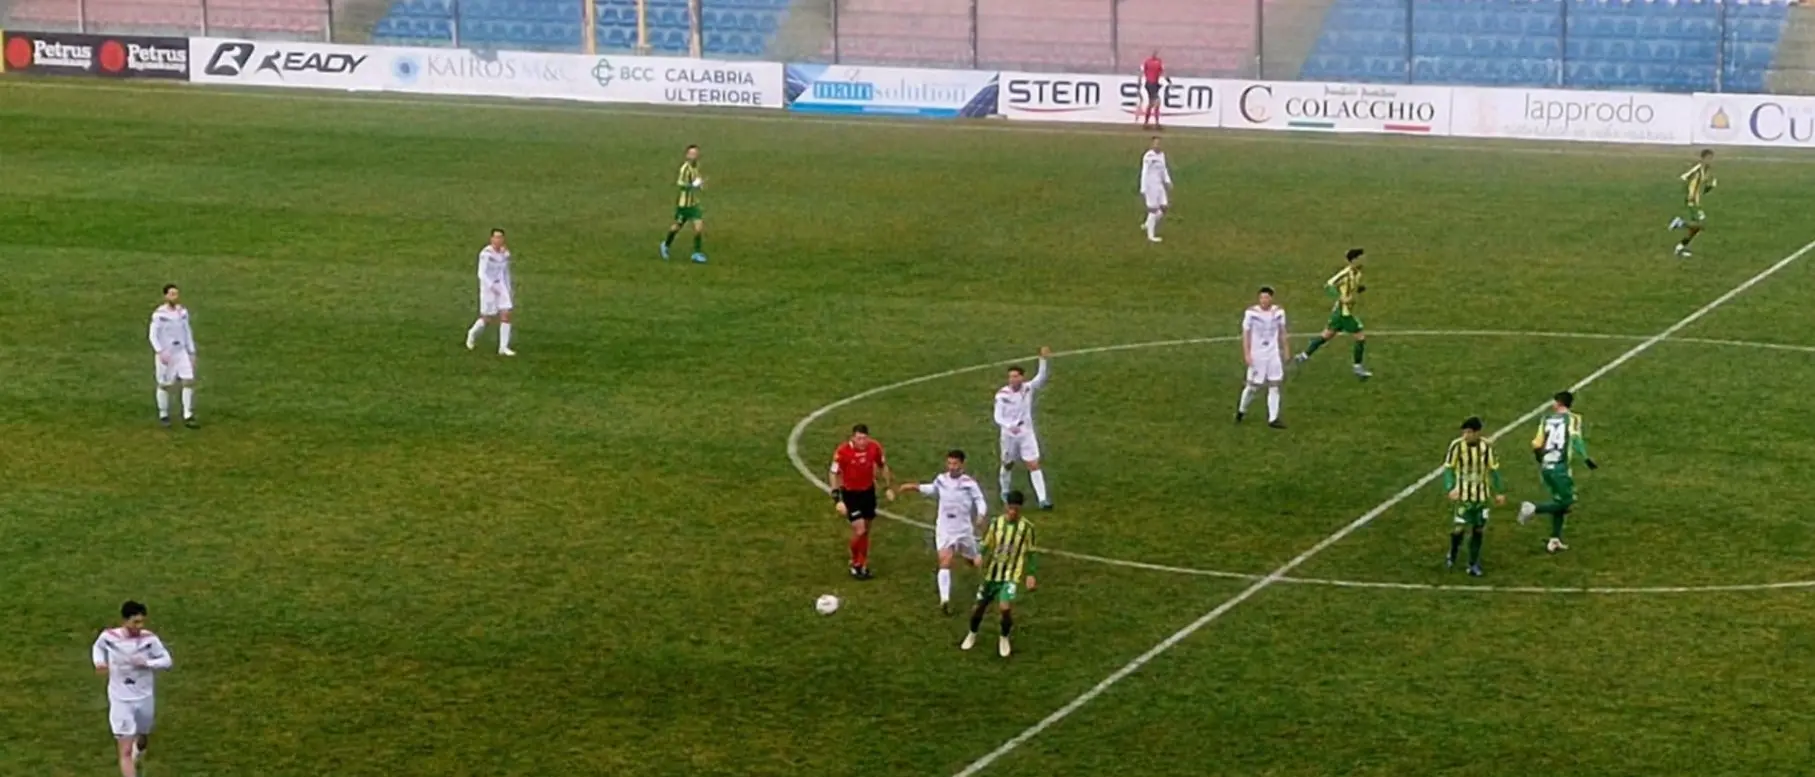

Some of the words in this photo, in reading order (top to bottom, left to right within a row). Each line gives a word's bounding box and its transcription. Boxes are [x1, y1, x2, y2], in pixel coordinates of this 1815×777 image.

[33, 40, 92, 58] Petrus
[127, 44, 186, 62] Petrus
[255, 51, 368, 80] READY
[427, 55, 516, 80] KAIROS
[620, 66, 655, 81] BCC
[665, 68, 755, 86] CALABRIA
[665, 88, 762, 105] ULTERIORE
[1009, 80, 1100, 105] STEM
[1120, 83, 1213, 109] SEM
[1286, 97, 1434, 122] COLACCHIO
